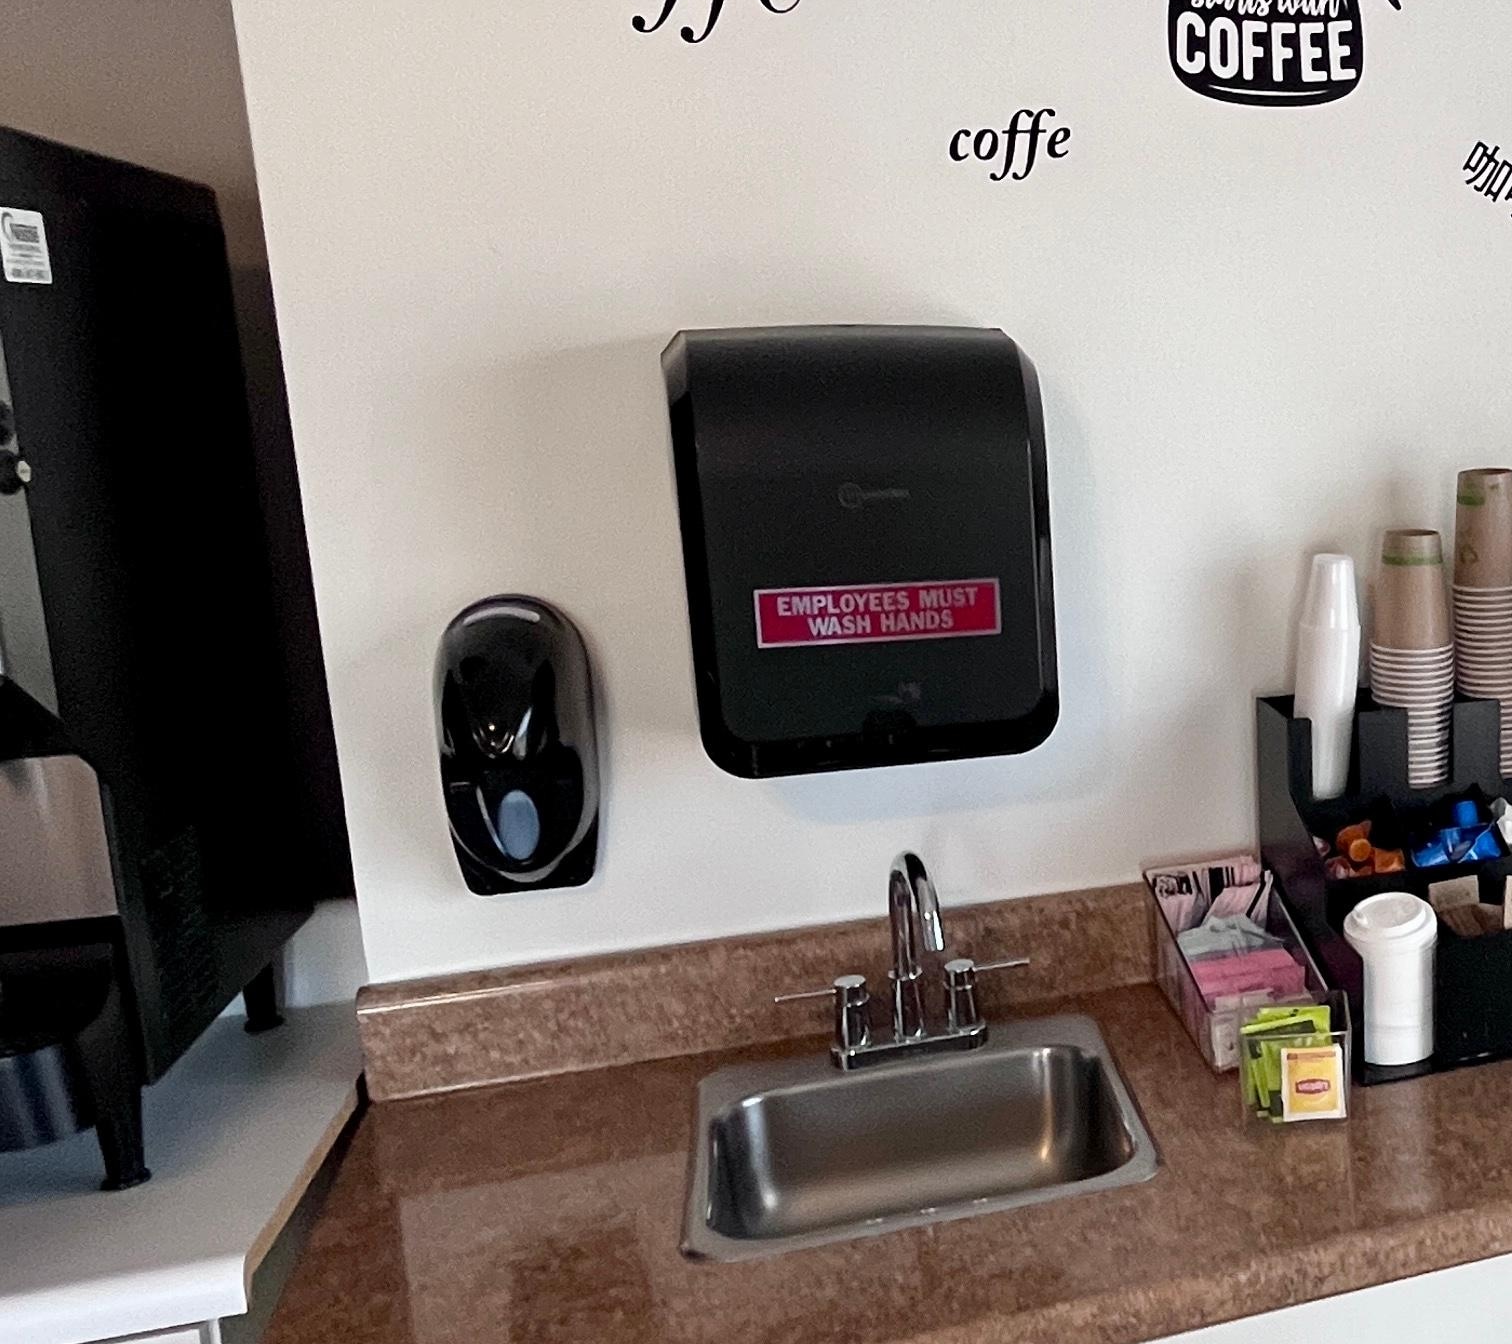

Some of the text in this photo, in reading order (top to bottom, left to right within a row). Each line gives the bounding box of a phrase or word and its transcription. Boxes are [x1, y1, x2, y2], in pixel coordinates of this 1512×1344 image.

[1175, 10, 1357, 83] COFFEE
[948, 108, 1071, 181] coffe
[776, 586, 979, 617] EMPLOYEES MUST
[807, 610, 955, 638] WASH HANDS
